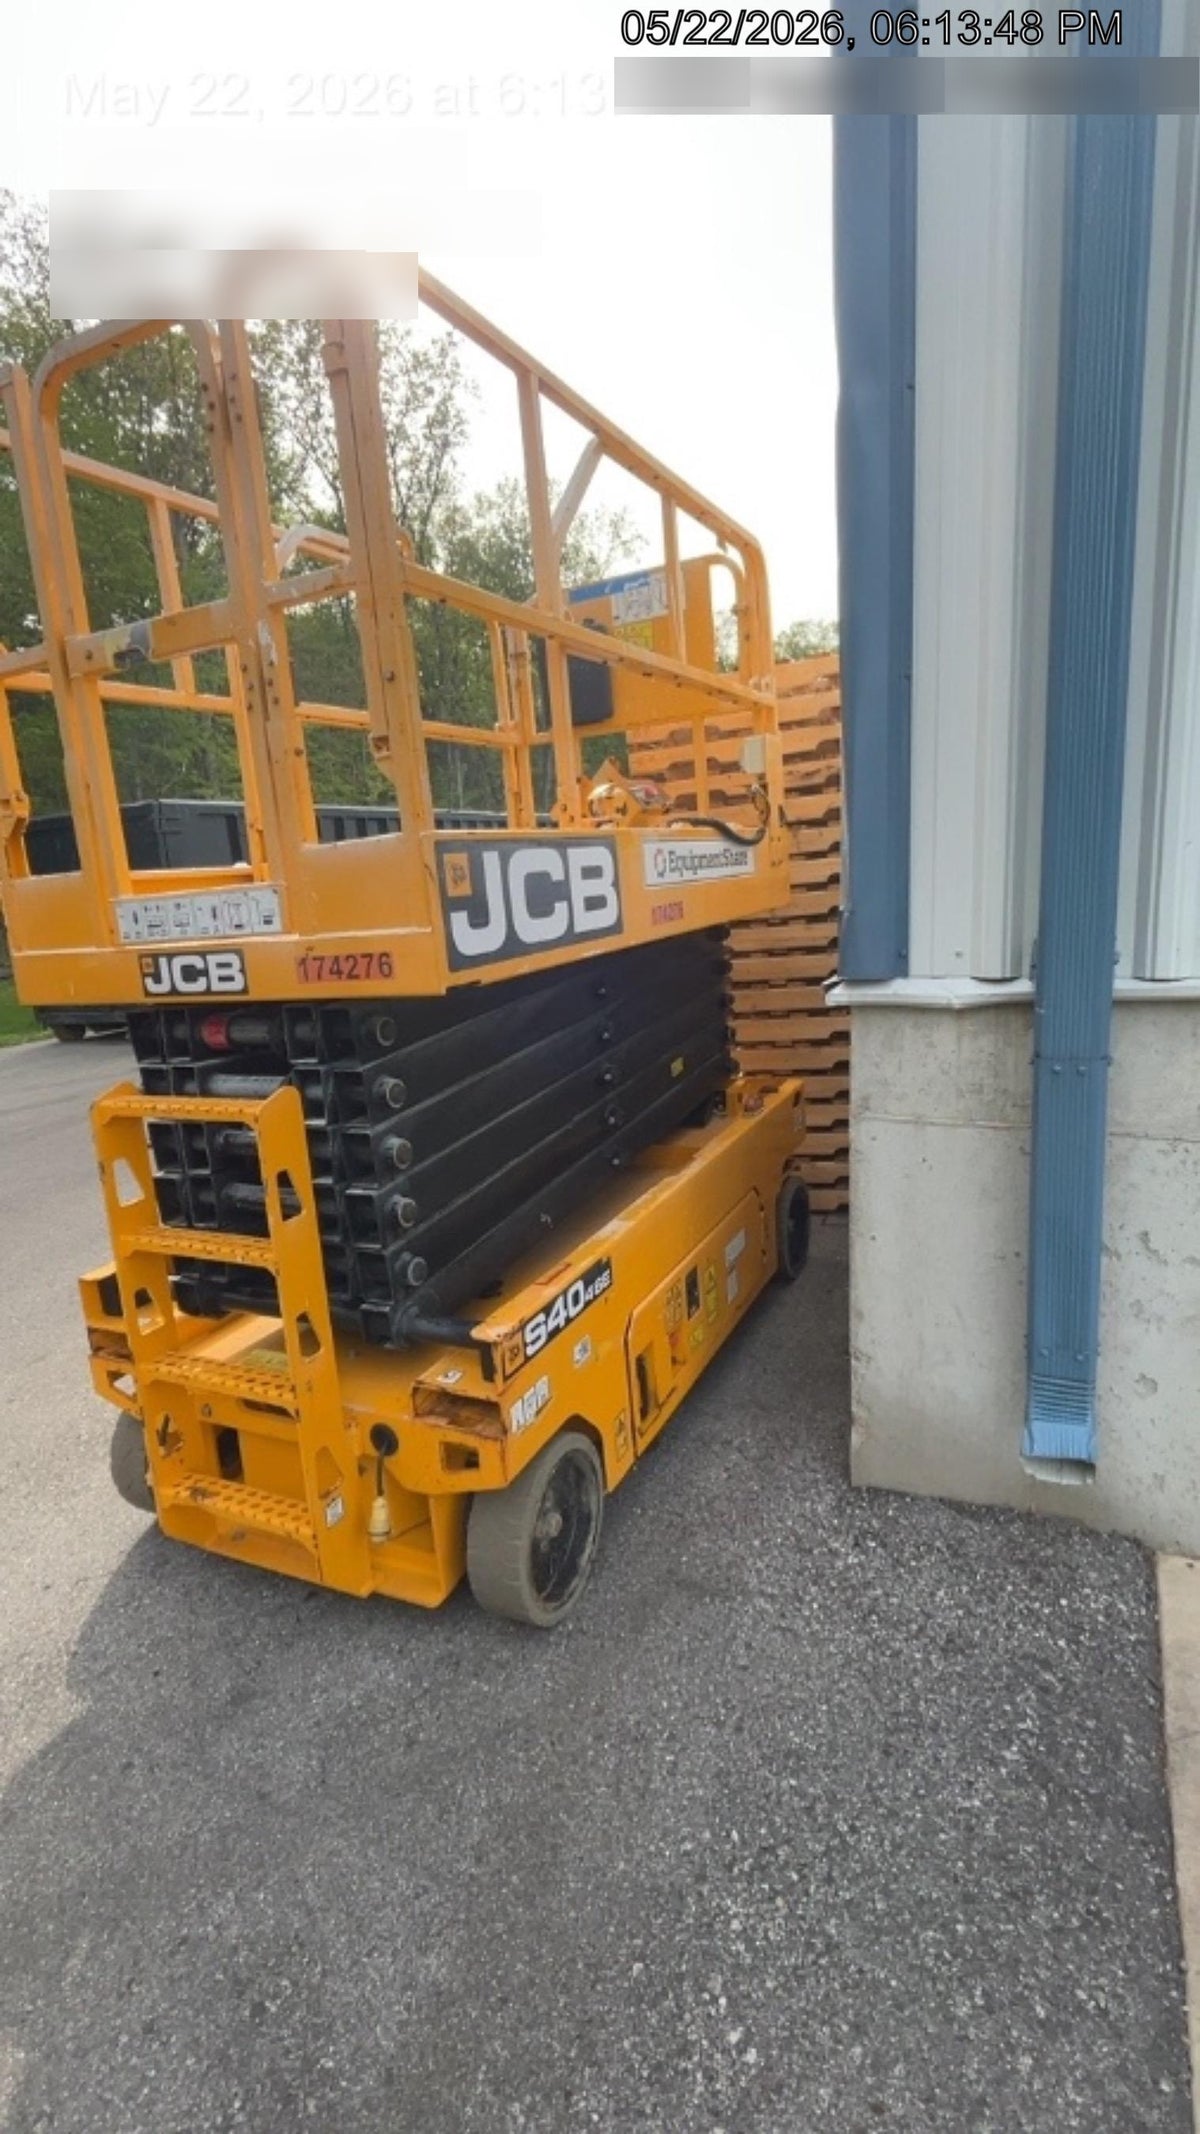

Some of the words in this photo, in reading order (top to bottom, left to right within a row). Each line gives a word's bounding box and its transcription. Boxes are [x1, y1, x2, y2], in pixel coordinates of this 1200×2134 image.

[450, 845, 620, 957] JCB
[144, 952, 246, 995] JCB
[298, 950, 393, 983] 174276
